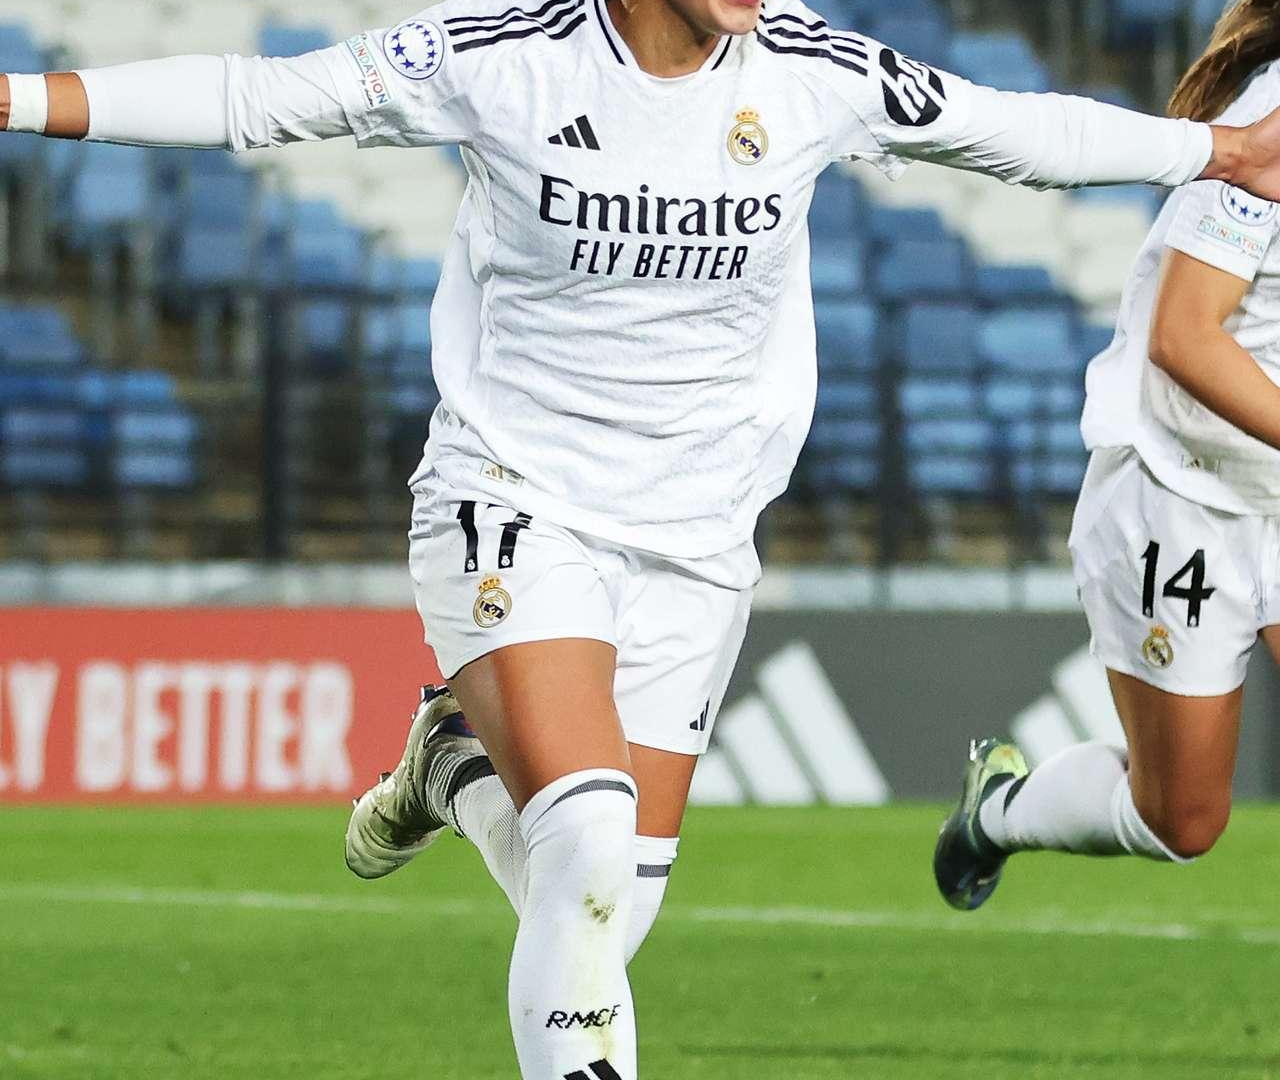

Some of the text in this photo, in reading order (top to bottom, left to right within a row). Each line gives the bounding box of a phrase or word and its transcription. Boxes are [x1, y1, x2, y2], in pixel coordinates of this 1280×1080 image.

[539, 173, 782, 237] Emirates
[570, 238, 749, 281] FLY BETTER
[1140, 540, 1217, 628] 14
[74, 658, 356, 793] BETTER
